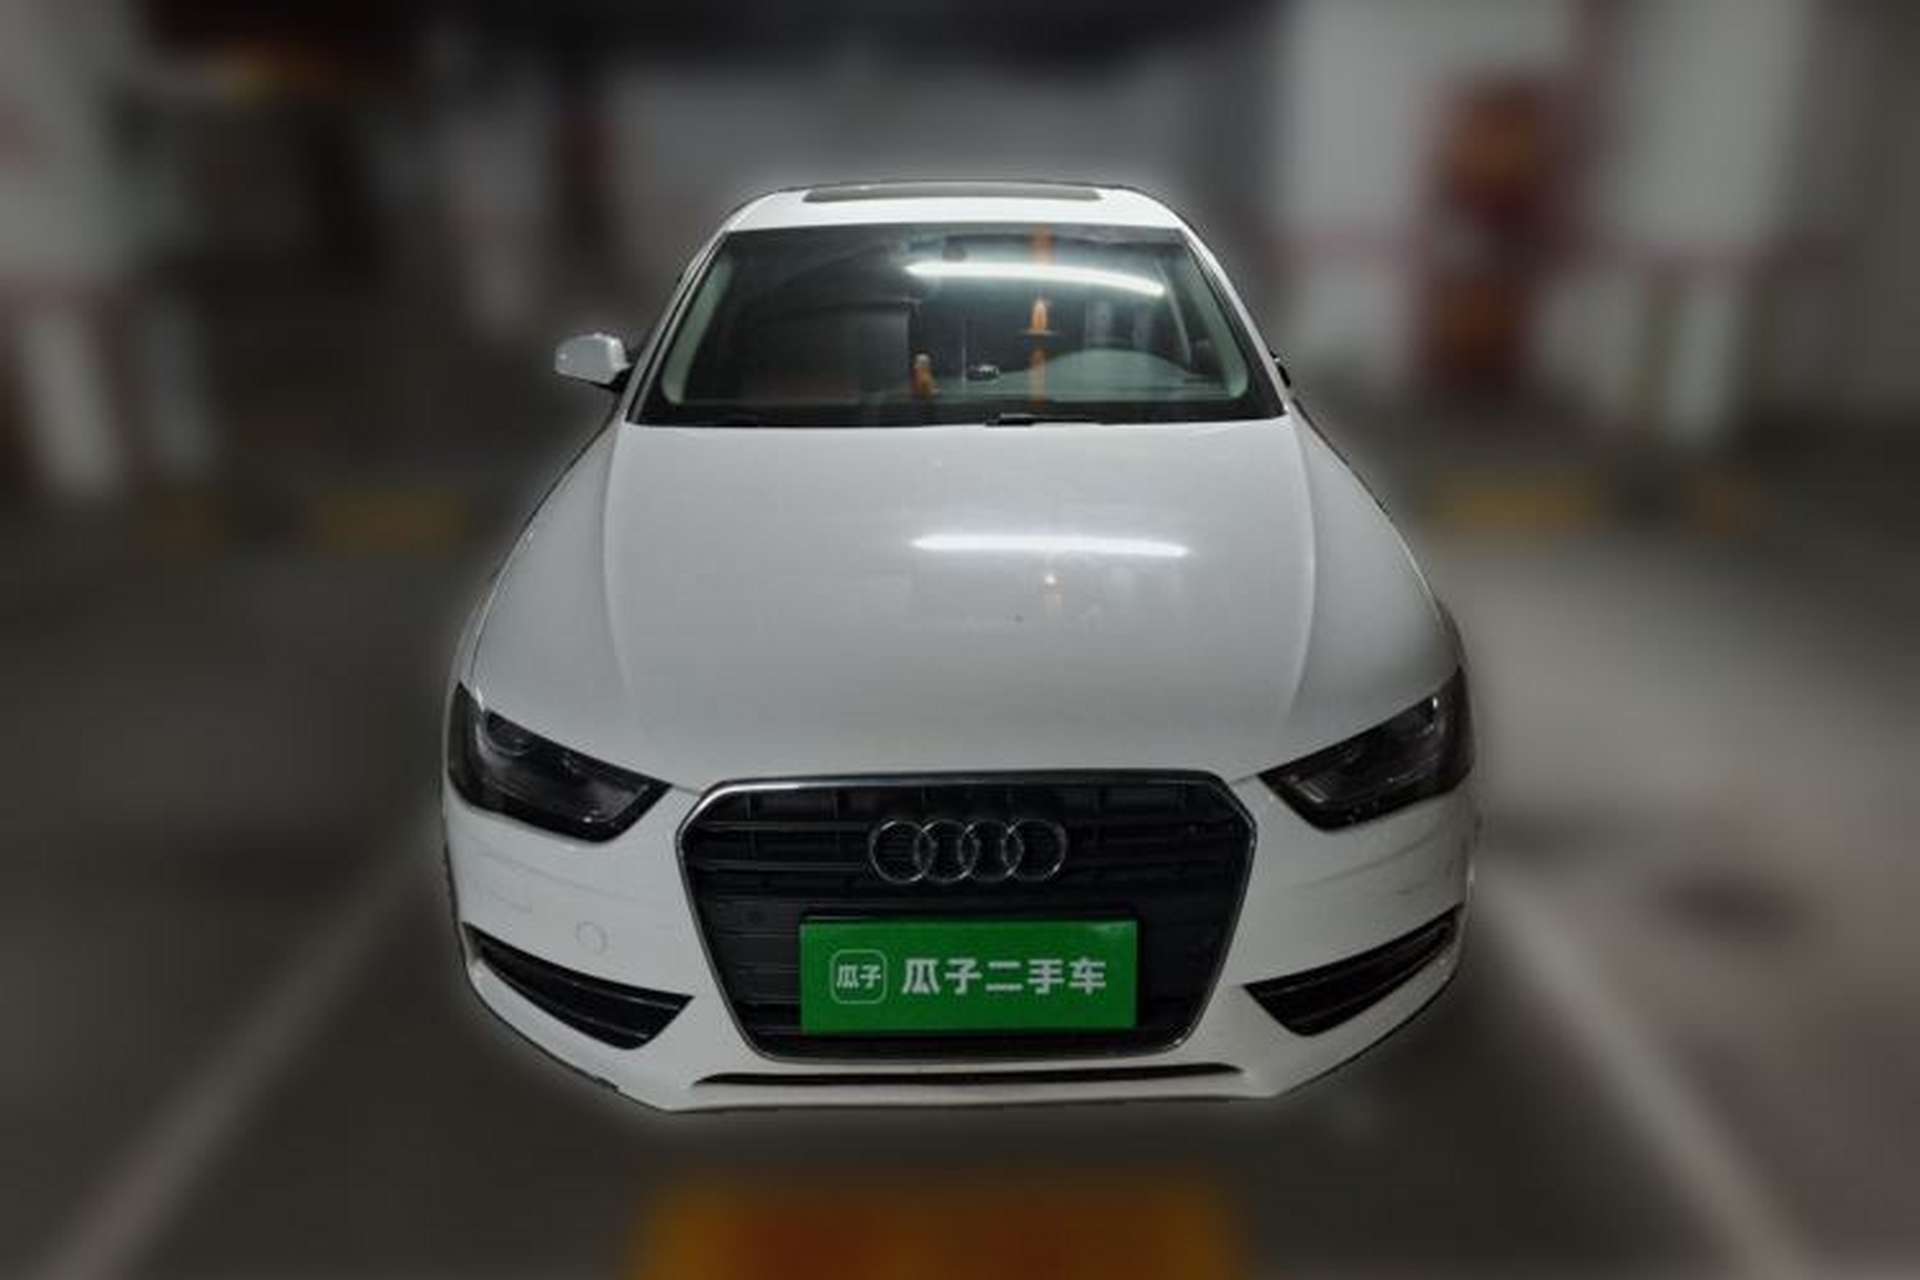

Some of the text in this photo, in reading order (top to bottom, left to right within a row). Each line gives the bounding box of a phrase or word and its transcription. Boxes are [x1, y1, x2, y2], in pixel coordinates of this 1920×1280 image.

[835, 964, 882, 990] 瓜子
[902, 957, 1107, 996] 瓜子二手车
